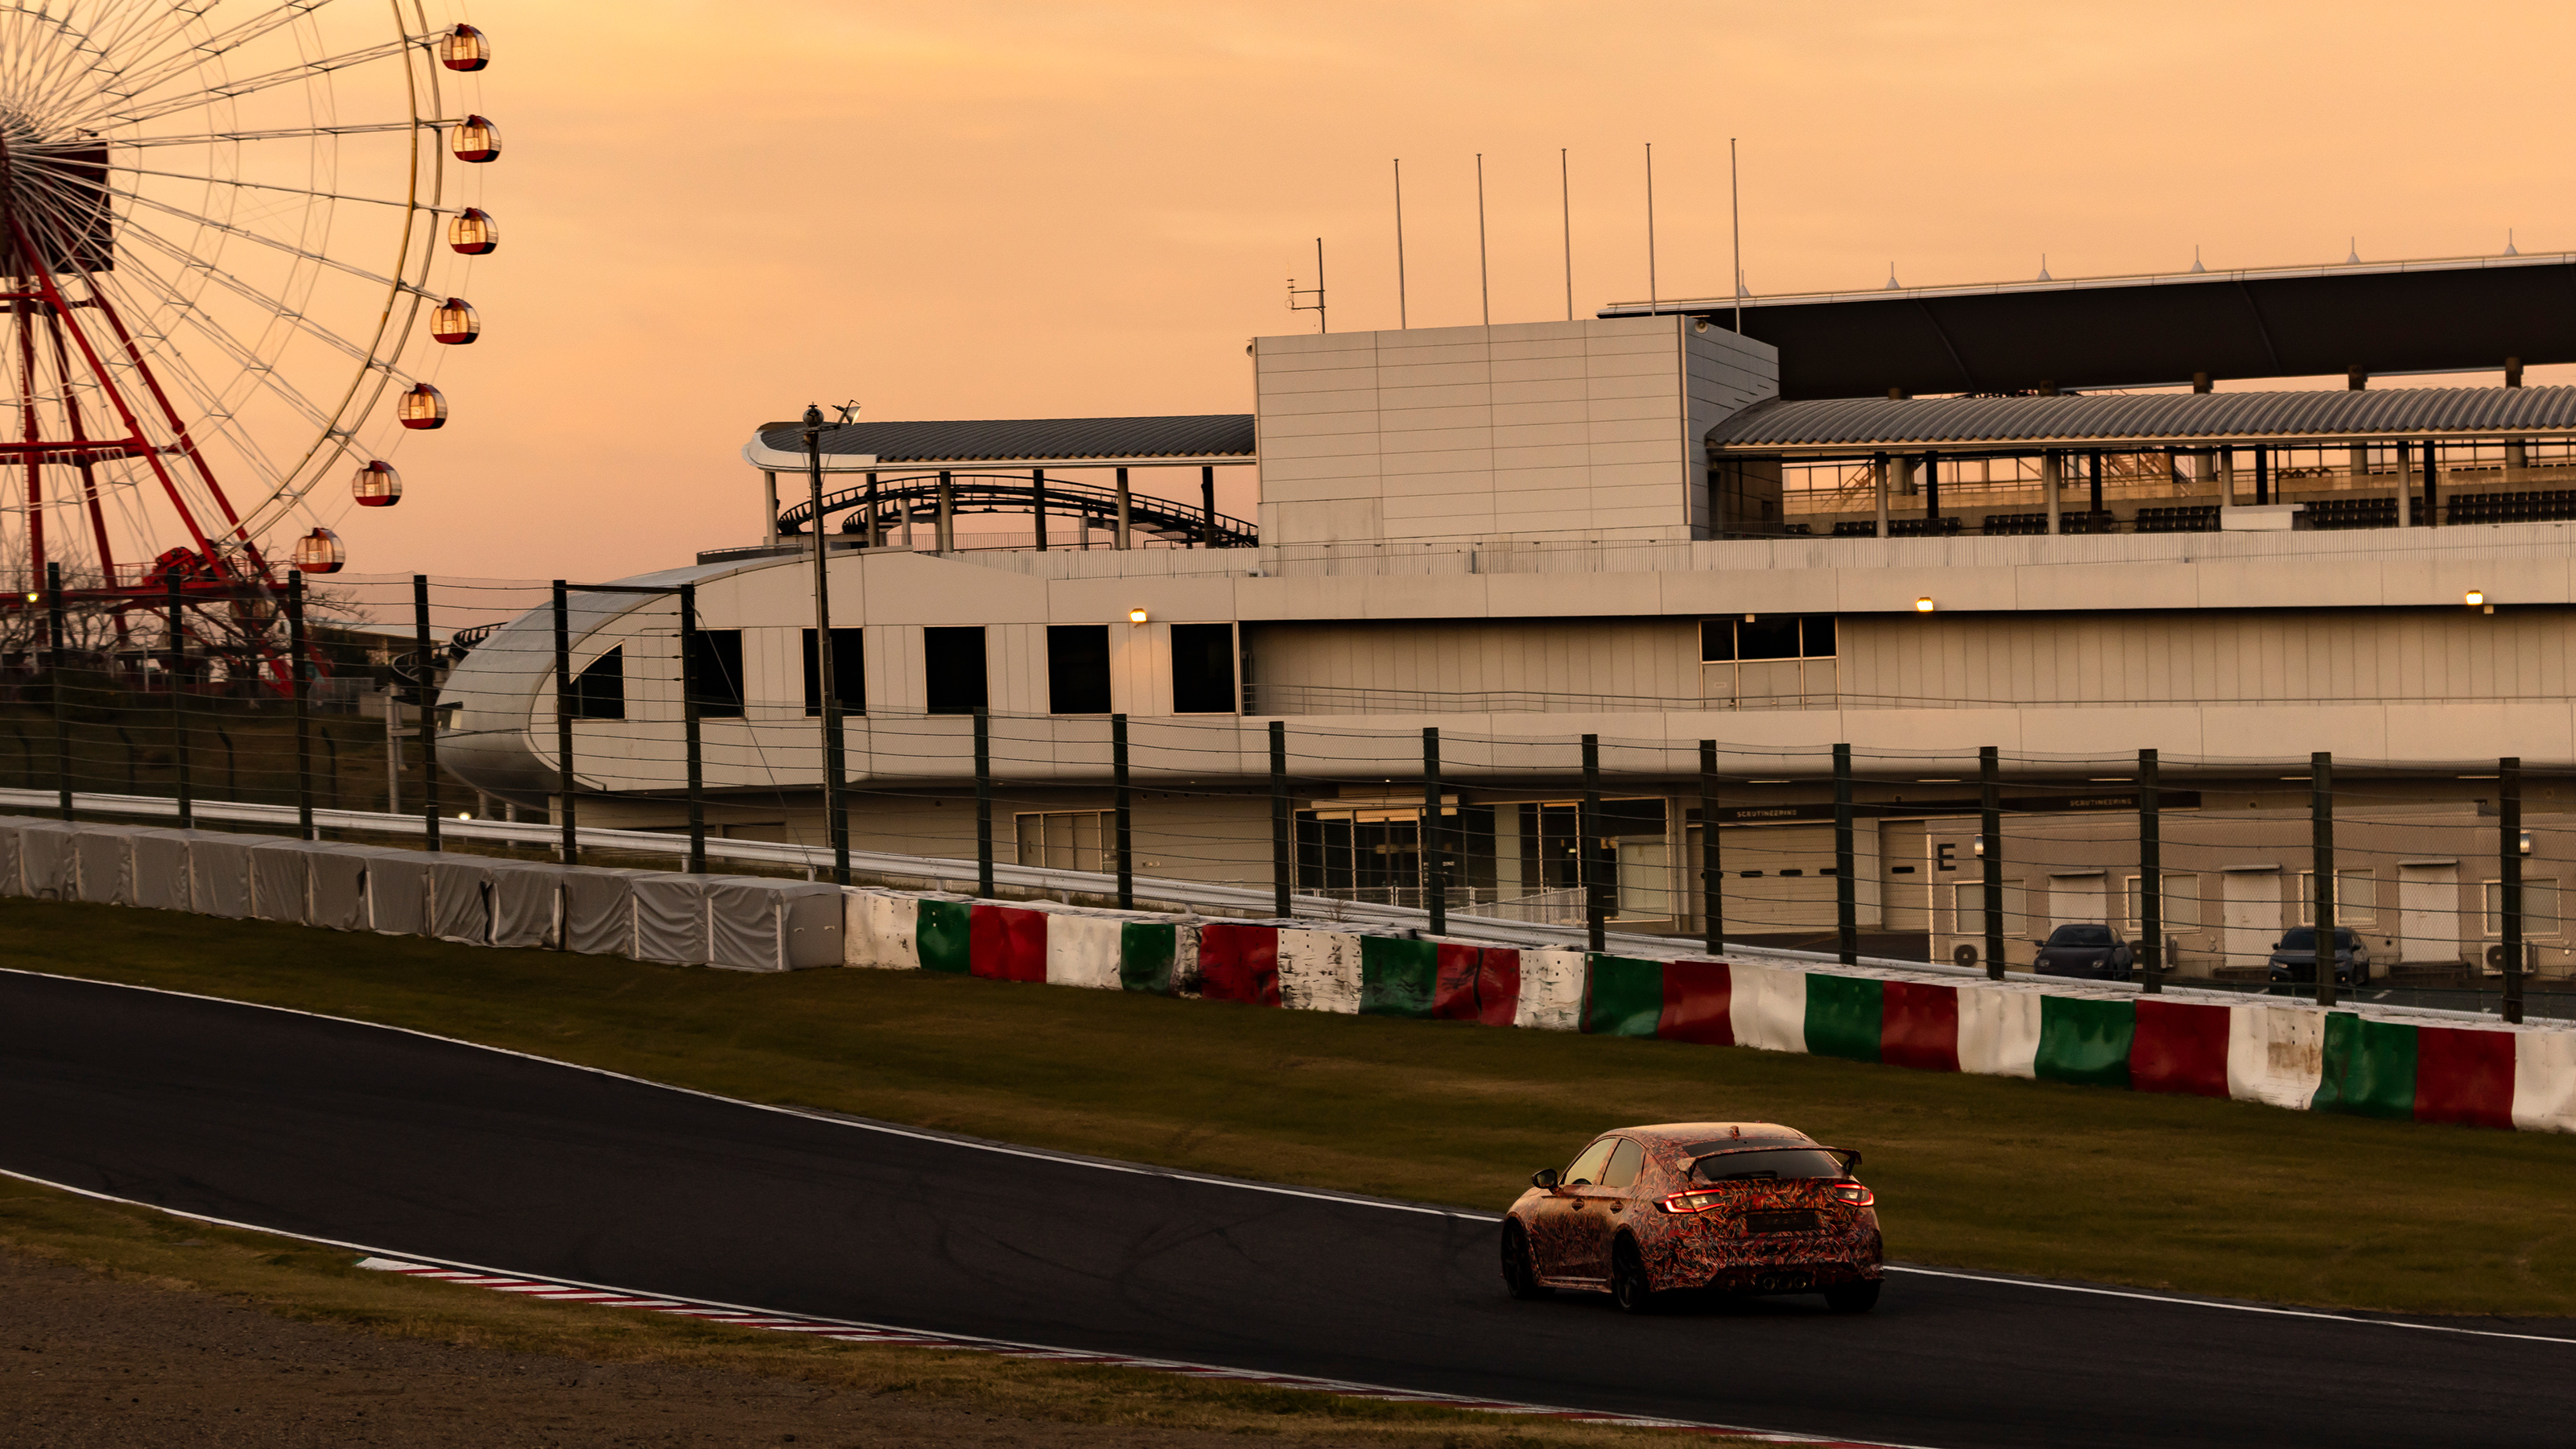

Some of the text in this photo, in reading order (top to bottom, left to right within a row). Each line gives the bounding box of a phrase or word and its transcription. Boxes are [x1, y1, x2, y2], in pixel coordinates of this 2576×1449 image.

[2070, 798, 2132, 807] SCRUTINEERING
[1736, 809, 1797, 818] SCRUTINEERING
[1938, 844, 1956, 871] E
